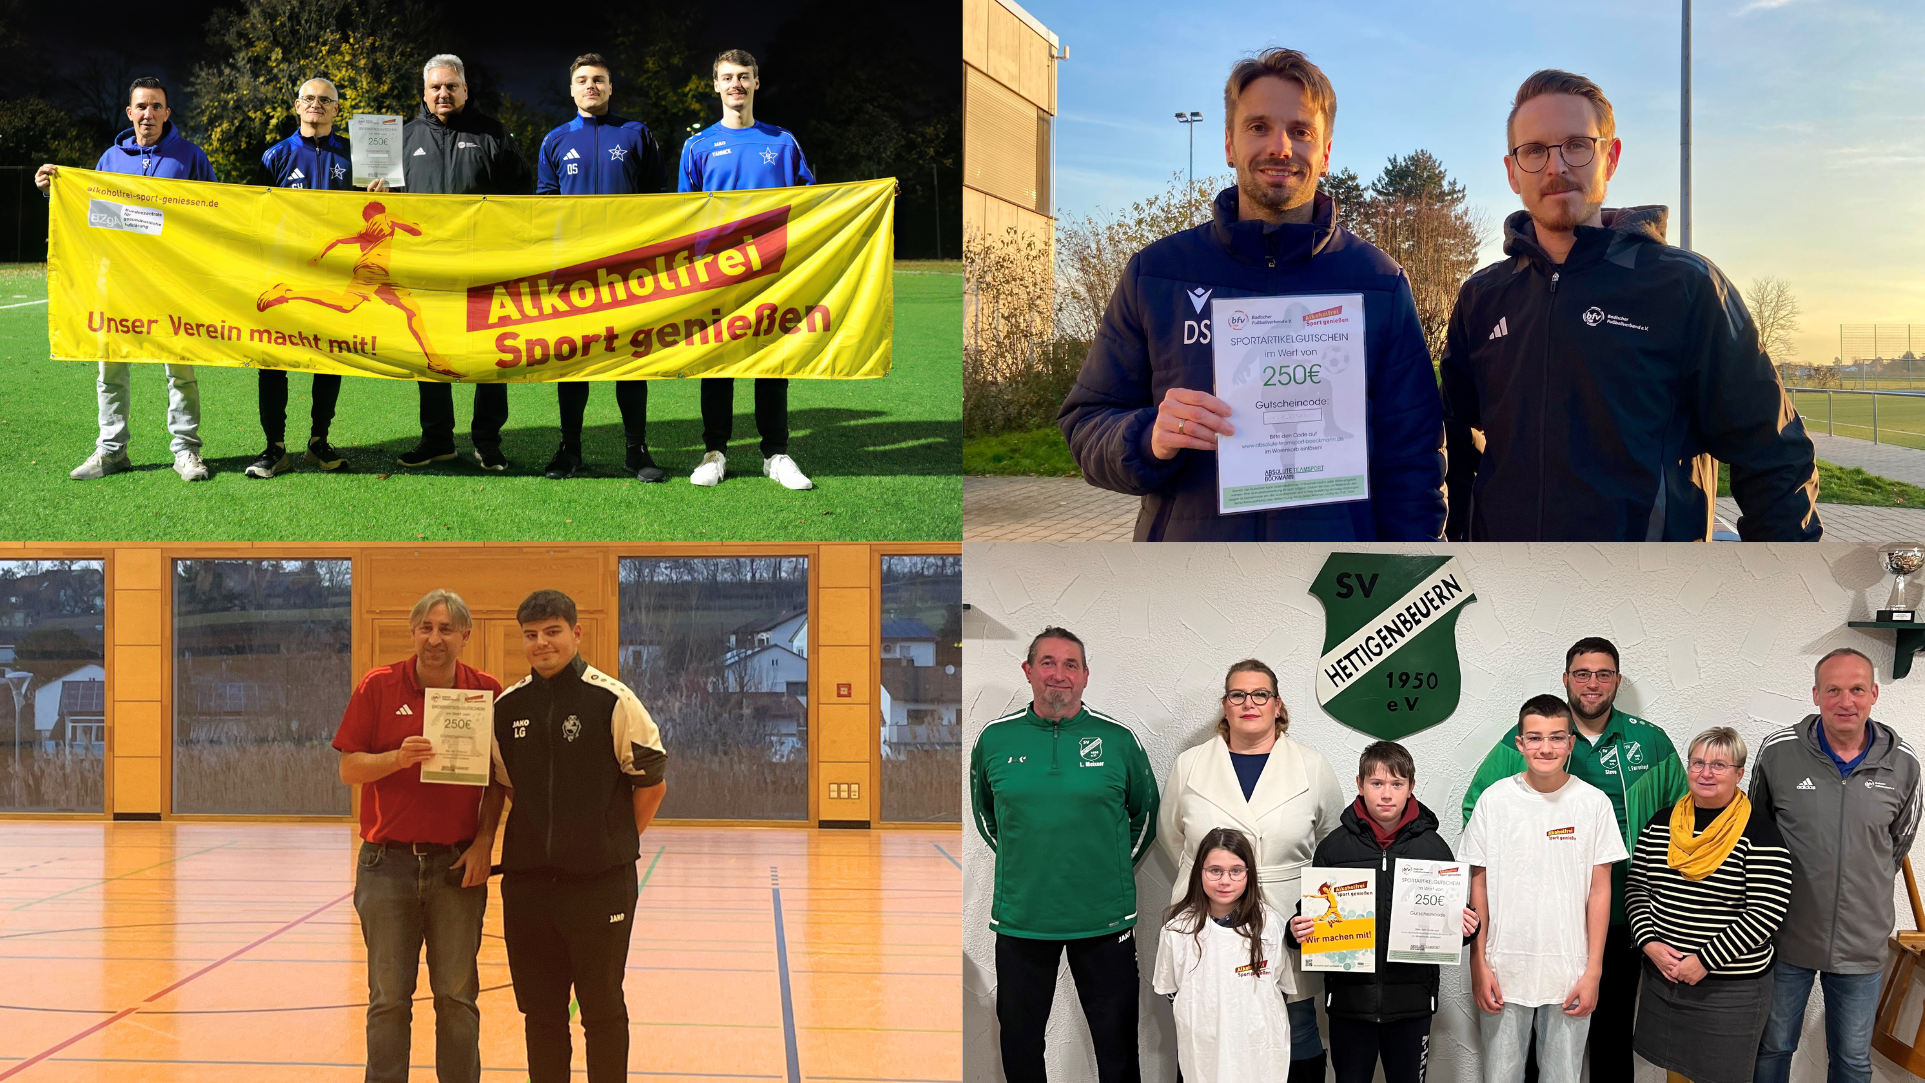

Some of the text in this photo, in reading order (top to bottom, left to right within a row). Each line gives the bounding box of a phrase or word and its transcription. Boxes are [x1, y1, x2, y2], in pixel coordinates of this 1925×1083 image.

[368, 138, 388, 146] 250€
[712, 148, 732, 157] YANNICK
[87, 186, 219, 208] alkoholfrei-sport-geniessen.de
[90, 213, 122, 227] BZgA
[488, 235, 762, 324] Alkoholfrei
[1232, 316, 1245, 325] bfv
[1304, 308, 1339, 321] Alkoholfrei
[1586, 312, 1601, 320] bfv
[88, 311, 377, 356] Unser Verein macht mit!
[495, 302, 830, 369] Sport genießen
[1184, 320, 1211, 344] DS
[1230, 333, 1349, 346] SPORTARTIKELGUTSCHEIN
[1264, 349, 1276, 358] im
[1278, 349, 1298, 357] Wert
[1263, 364, 1322, 387] 250€
[1255, 398, 1329, 409] Gutscheincode:
[1336, 572, 1379, 599] SV
[1324, 574, 1462, 687] HETTIGENBEUERN
[1387, 672, 1438, 690] 1950
[444, 719, 472, 730] 250€
[512, 719, 530, 728] JAKO
[514, 727, 526, 738] LG
[1415, 894, 1445, 906] 250€
[610, 913, 624, 923] JAKO
[1322, 934, 1354, 942] machen
